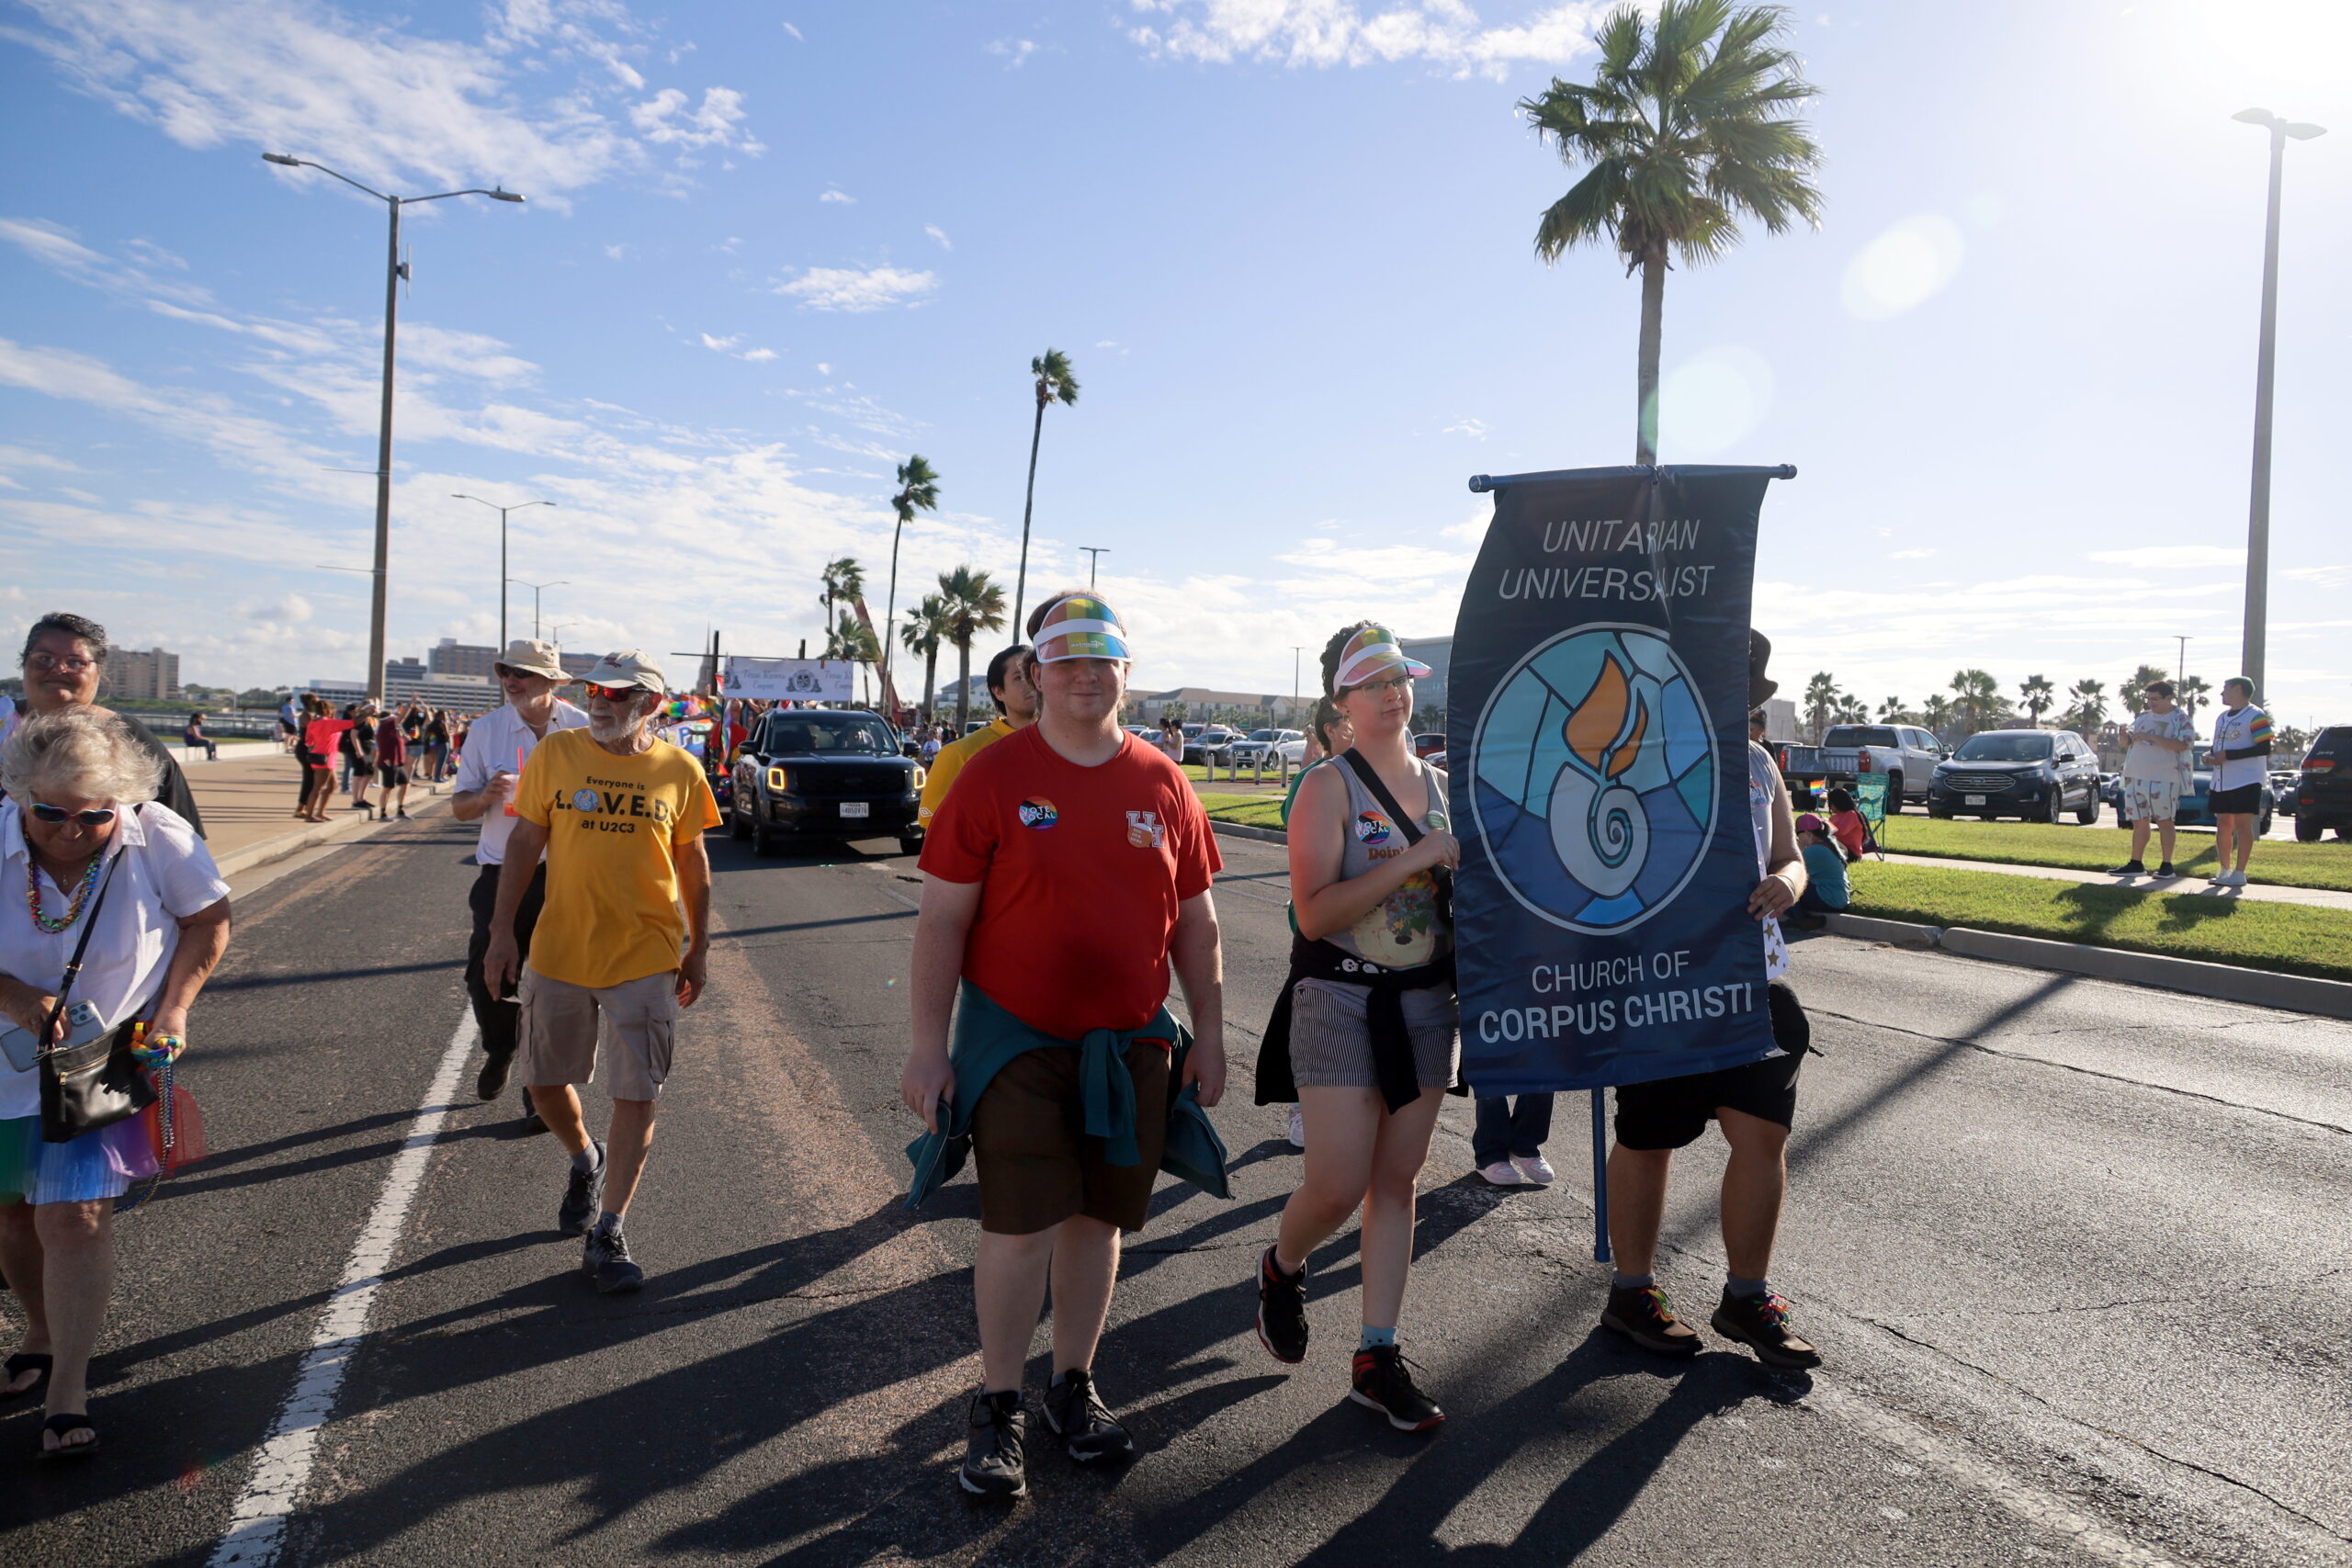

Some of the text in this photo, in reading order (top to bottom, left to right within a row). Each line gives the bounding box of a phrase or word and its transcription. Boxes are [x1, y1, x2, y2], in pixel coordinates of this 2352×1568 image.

[1543, 519, 1701, 555] UNITARIAN
[1498, 565, 1715, 602] UNIVERSALIST
[586, 776, 645, 790] Everyone is
[1021, 806, 1051, 817] VOTE
[1023, 812, 1057, 822] LOCAL
[582, 819, 636, 833] at U2C3
[1358, 820, 1385, 830] VOTE
[1359, 827, 1389, 837] LOCAL
[1532, 950, 1690, 994] CHURCH OF
[1478, 982, 1752, 1043] CORPUS CHRISTI
